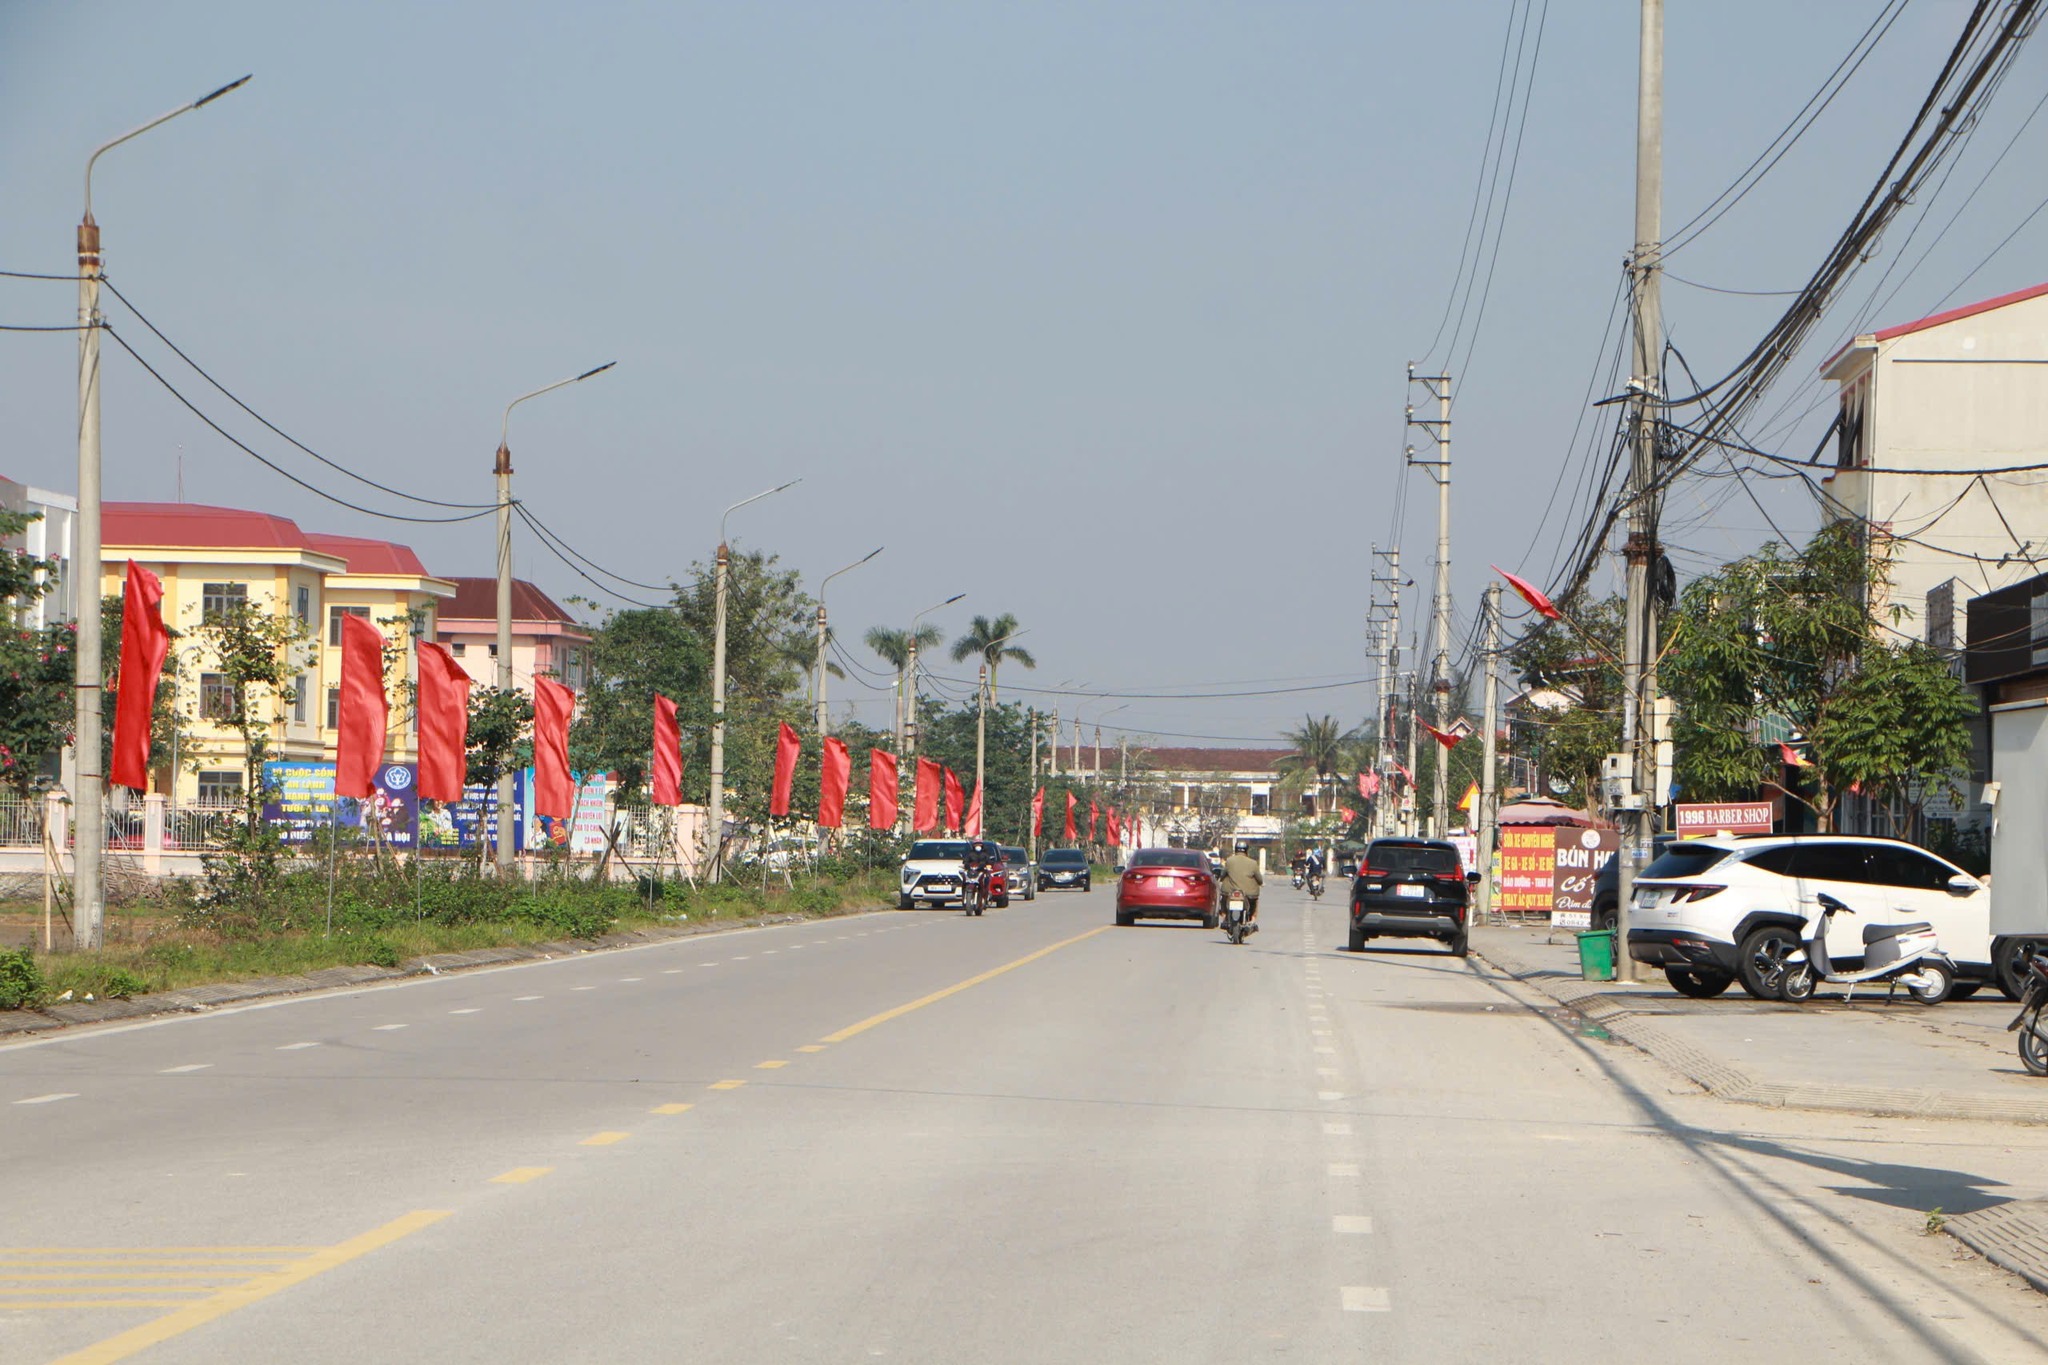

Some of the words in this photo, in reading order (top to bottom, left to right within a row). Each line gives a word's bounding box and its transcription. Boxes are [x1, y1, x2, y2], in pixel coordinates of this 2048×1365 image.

[314, 766, 336, 777] SỐN
[1680, 810, 1704, 824] 1996
[1706, 808, 1742, 824] BARBER
[1744, 808, 1769, 823] SHOP
[1514, 834, 1521, 848] XE
[1504, 856, 1510, 870] XE
[1522, 856, 1528, 870] XE
[1539, 857, 1546, 871] XE
[1557, 845, 1589, 868] BÚN
[1504, 893, 1517, 906] THAY
[1537, 894, 1544, 906] XE
